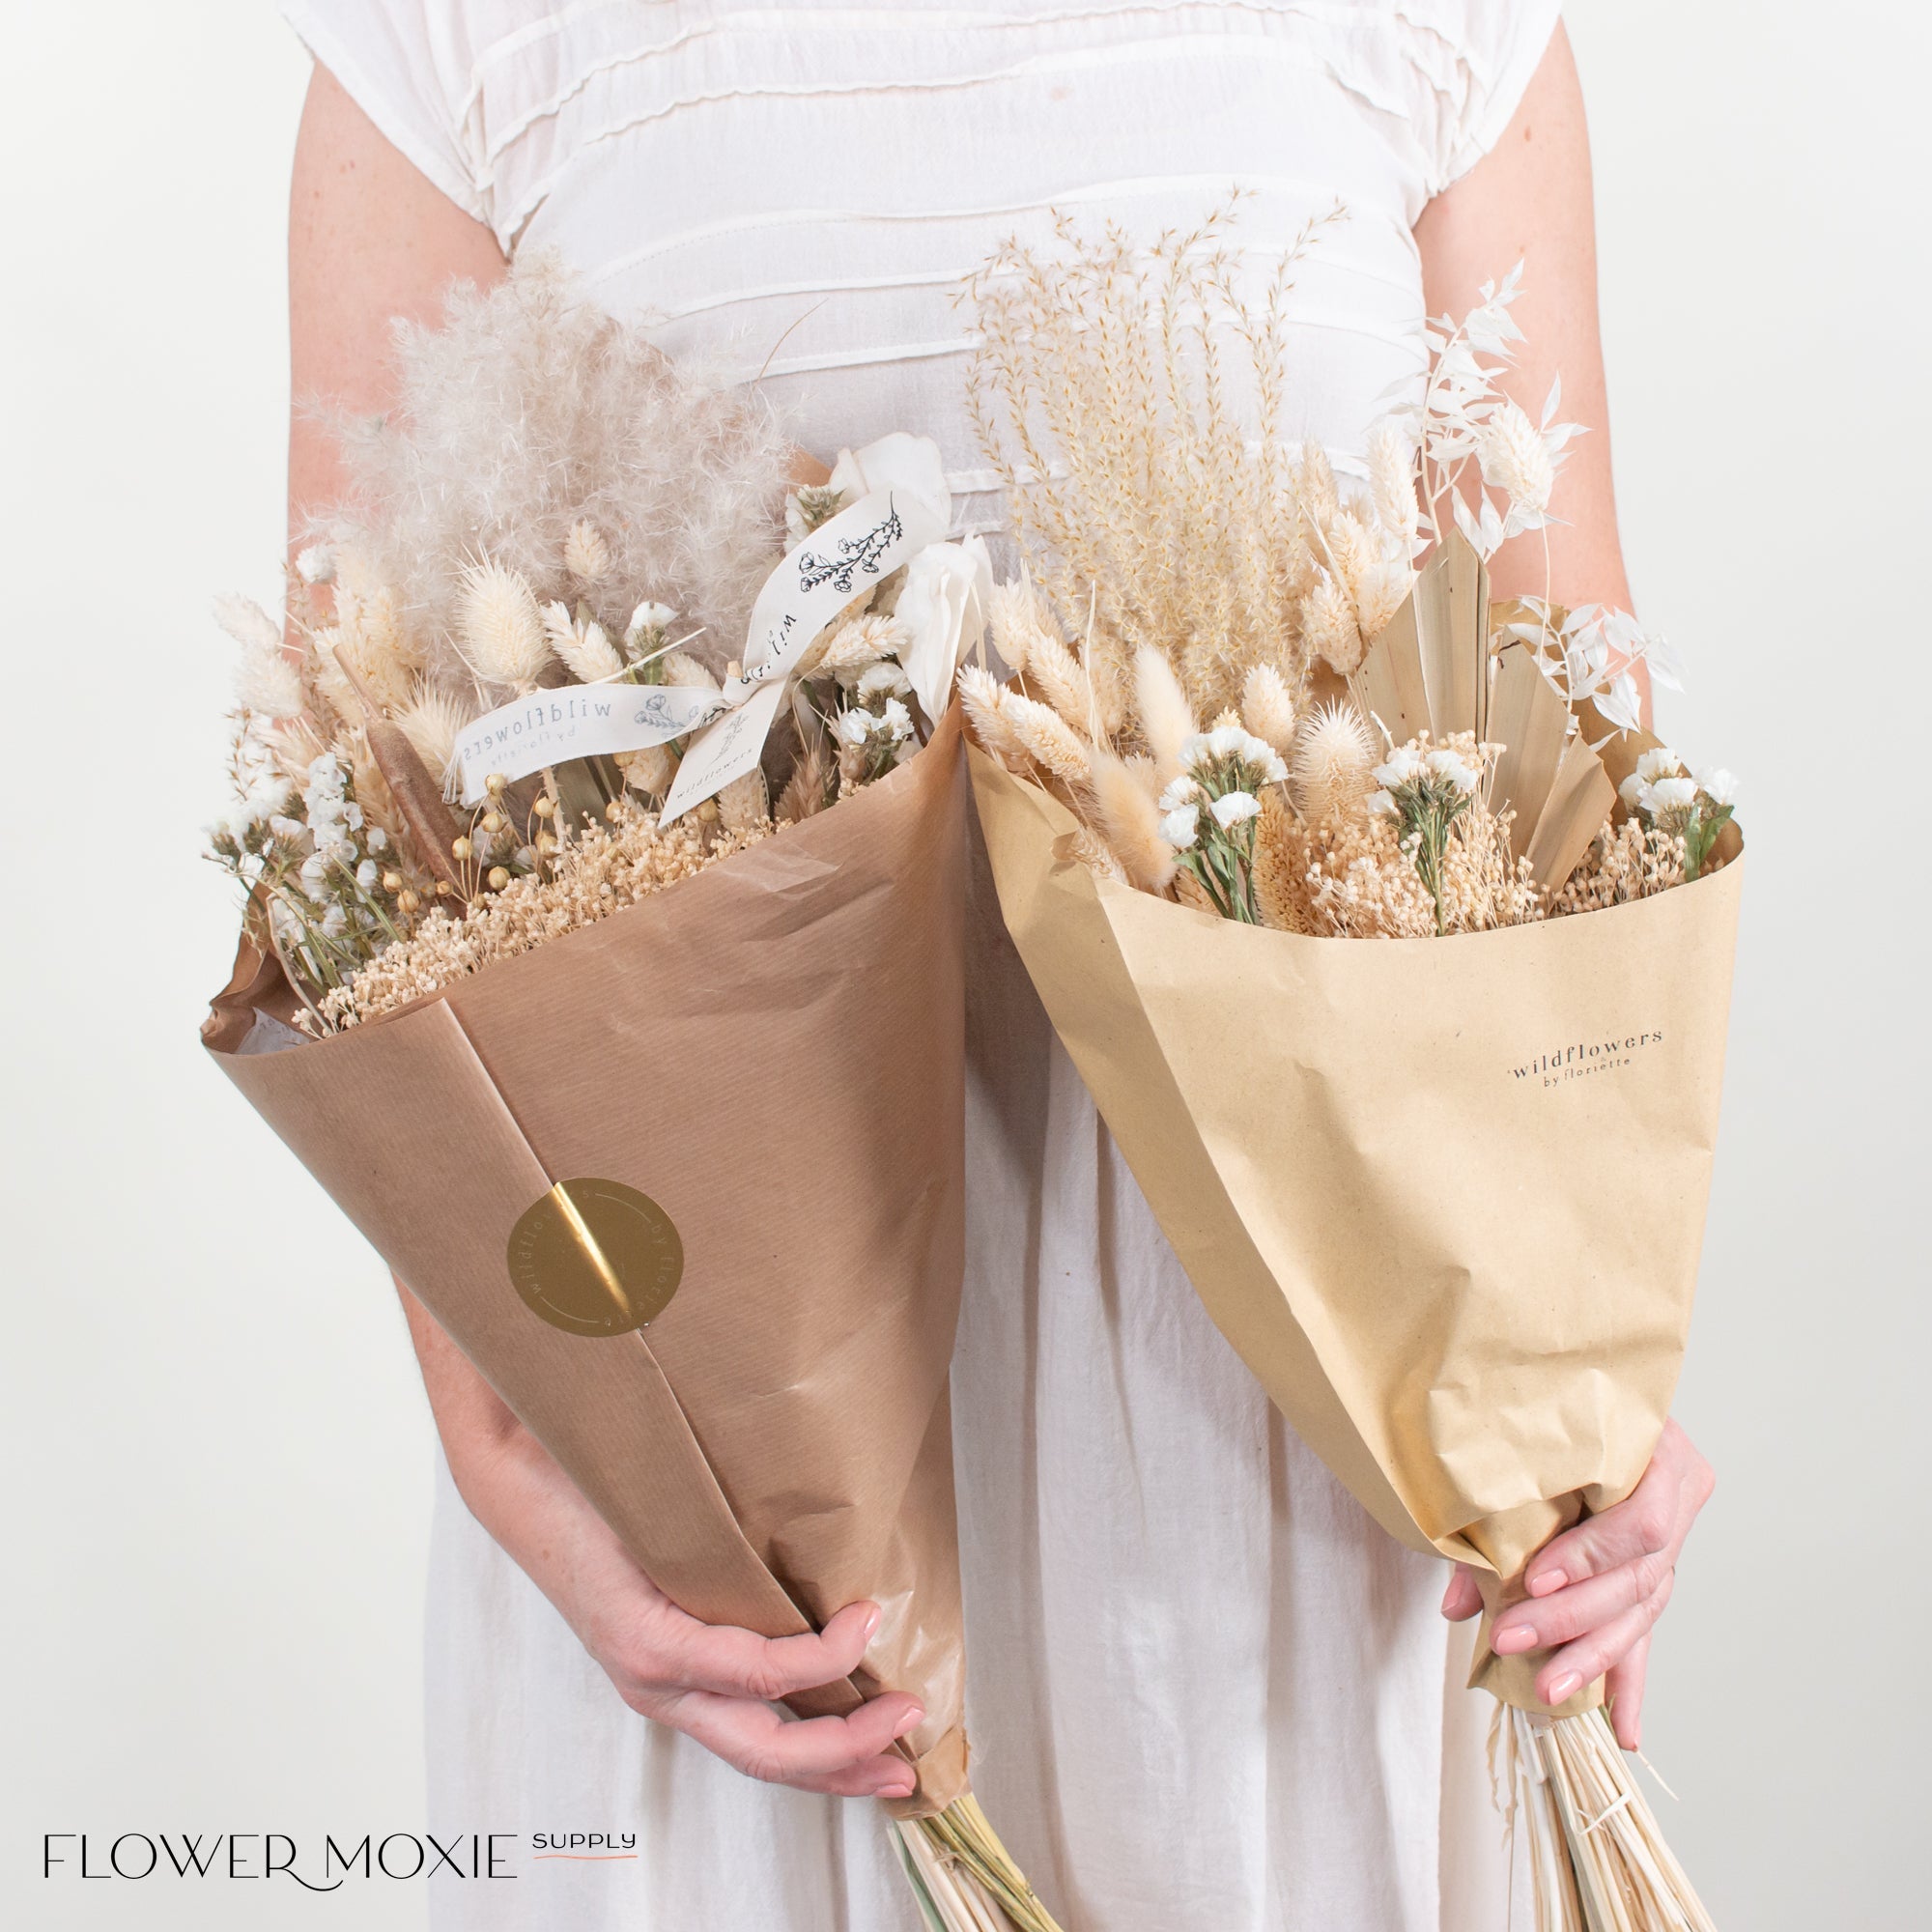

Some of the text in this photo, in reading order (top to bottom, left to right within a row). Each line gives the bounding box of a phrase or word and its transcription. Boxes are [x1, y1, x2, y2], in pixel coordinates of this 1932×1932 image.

[1513, 1030, 1662, 1079] wildflowers
[1543, 1057, 1631, 1088] by floriette
